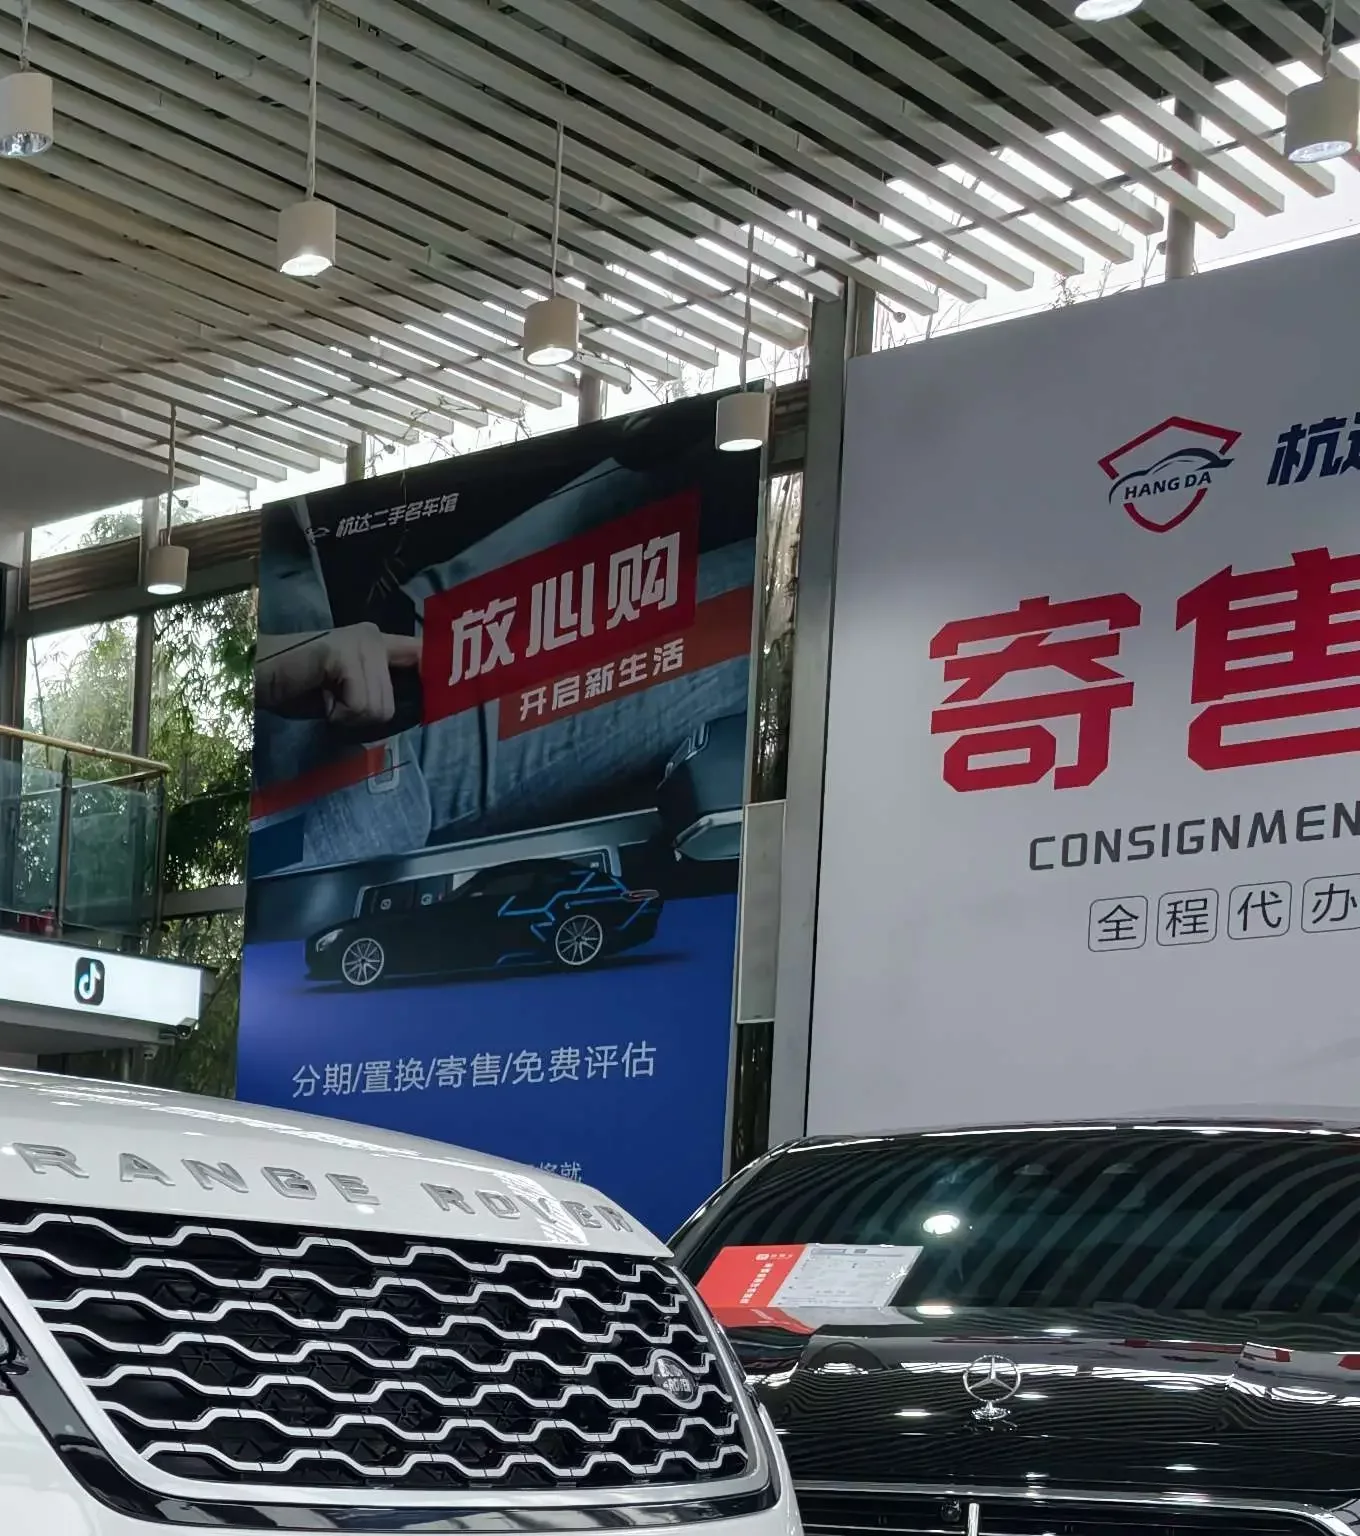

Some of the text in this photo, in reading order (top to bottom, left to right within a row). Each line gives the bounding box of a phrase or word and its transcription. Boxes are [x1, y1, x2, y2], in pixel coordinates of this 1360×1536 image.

[1124, 469, 1212, 500] HANG DA
[1267, 411, 1360, 486] 杭
[335, 492, 460, 539] 杭达二手名车馆
[448, 531, 681, 688] 放心购
[519, 637, 685, 722] 开启新生活
[928, 546, 1360, 793] 寄售
[1028, 800, 1360, 872] CONSIGNMEN
[291, 1040, 658, 1099] 分期/置换/寄售/免费评估
[10, 1140, 635, 1234] RANGE ROVER
